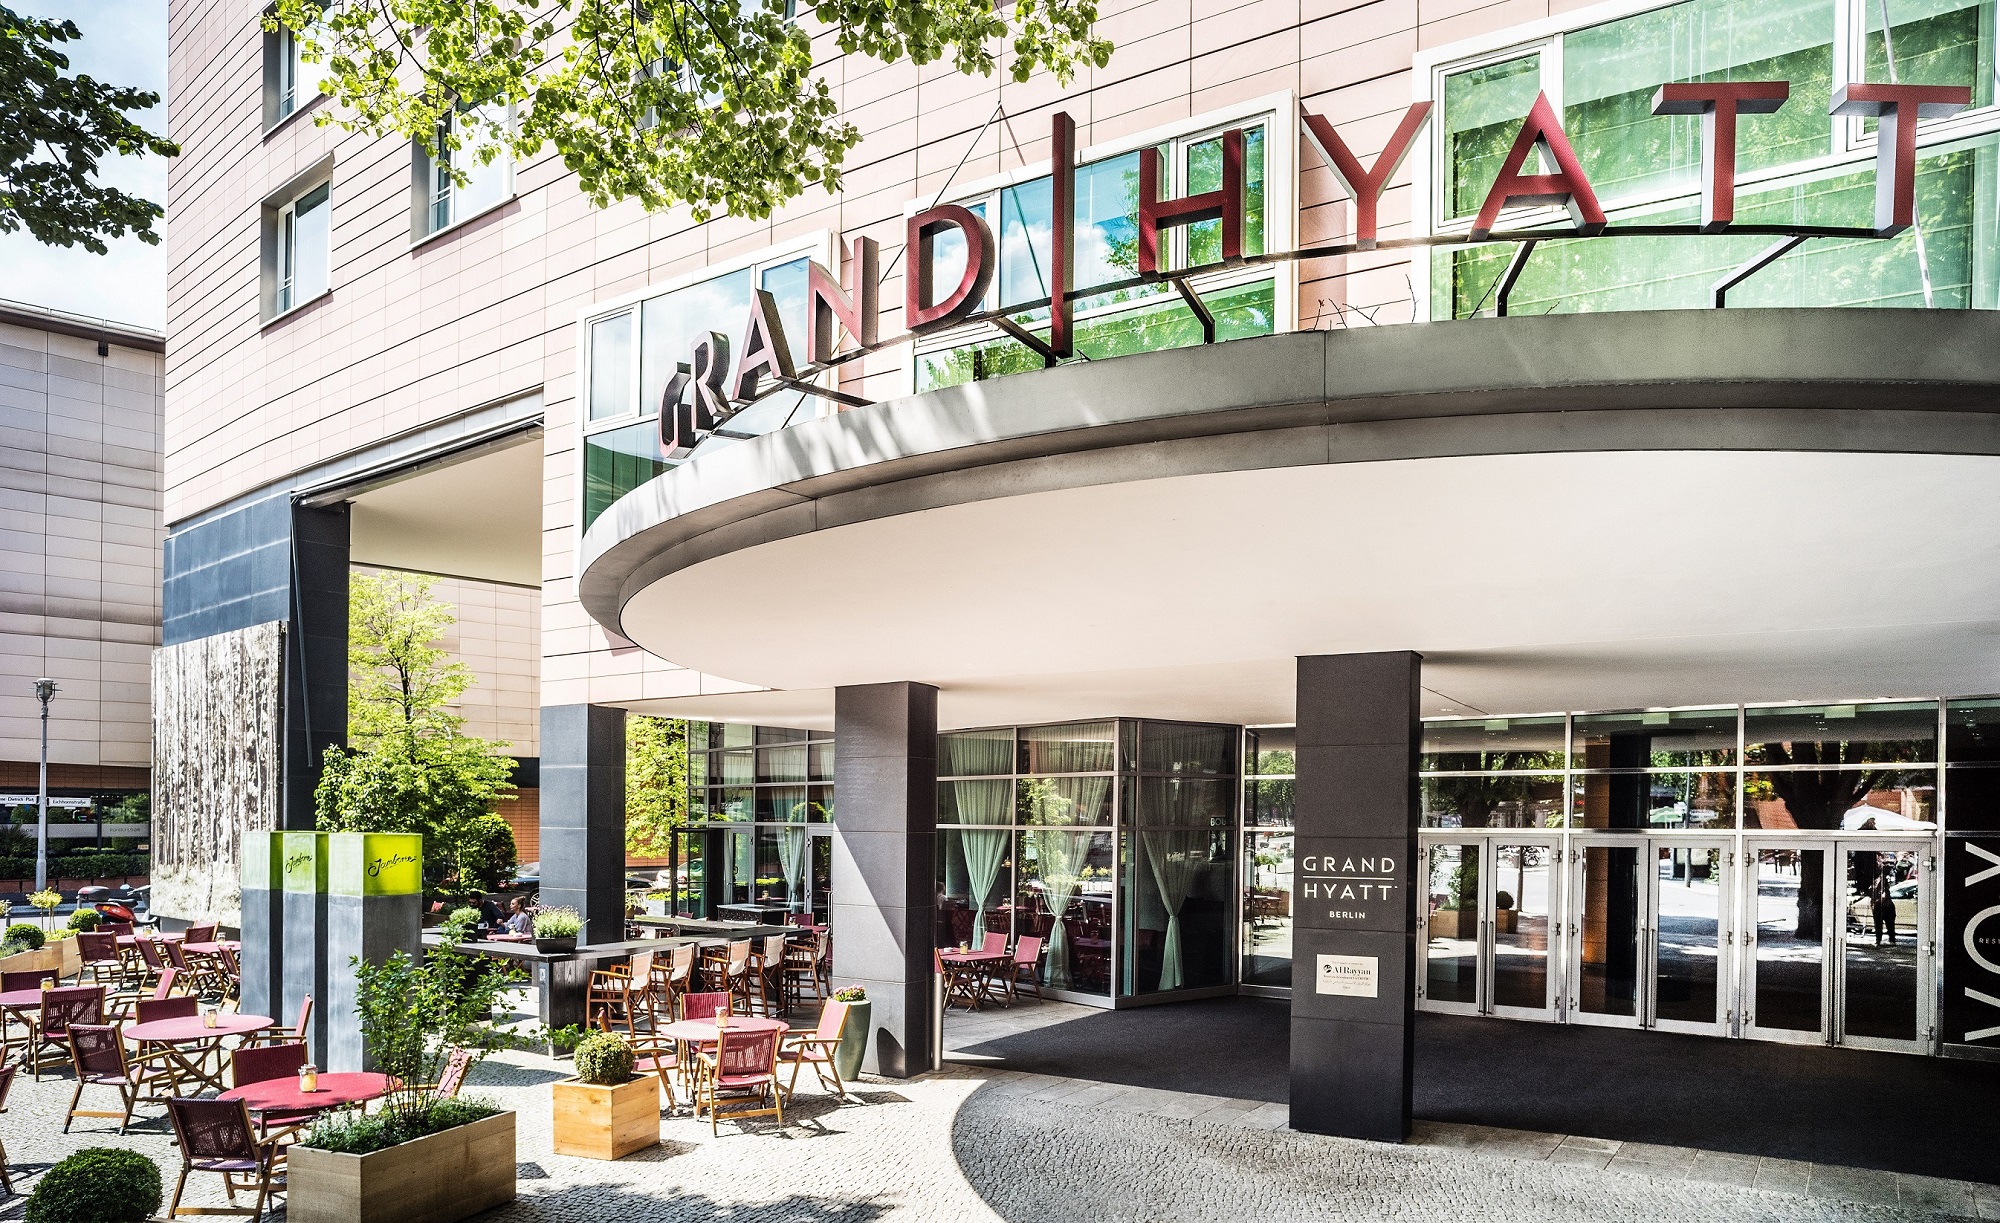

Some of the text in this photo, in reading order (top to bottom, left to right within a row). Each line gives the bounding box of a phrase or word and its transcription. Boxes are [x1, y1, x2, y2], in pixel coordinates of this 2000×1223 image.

[659, 79, 1971, 460] GRAND HYATT
[1302, 856, 1395, 873] GRAND
[1304, 883, 1394, 901] HYATT
[1329, 910, 1366, 919] BERLIN
[1343, 966, 1371, 977] Rayyan
